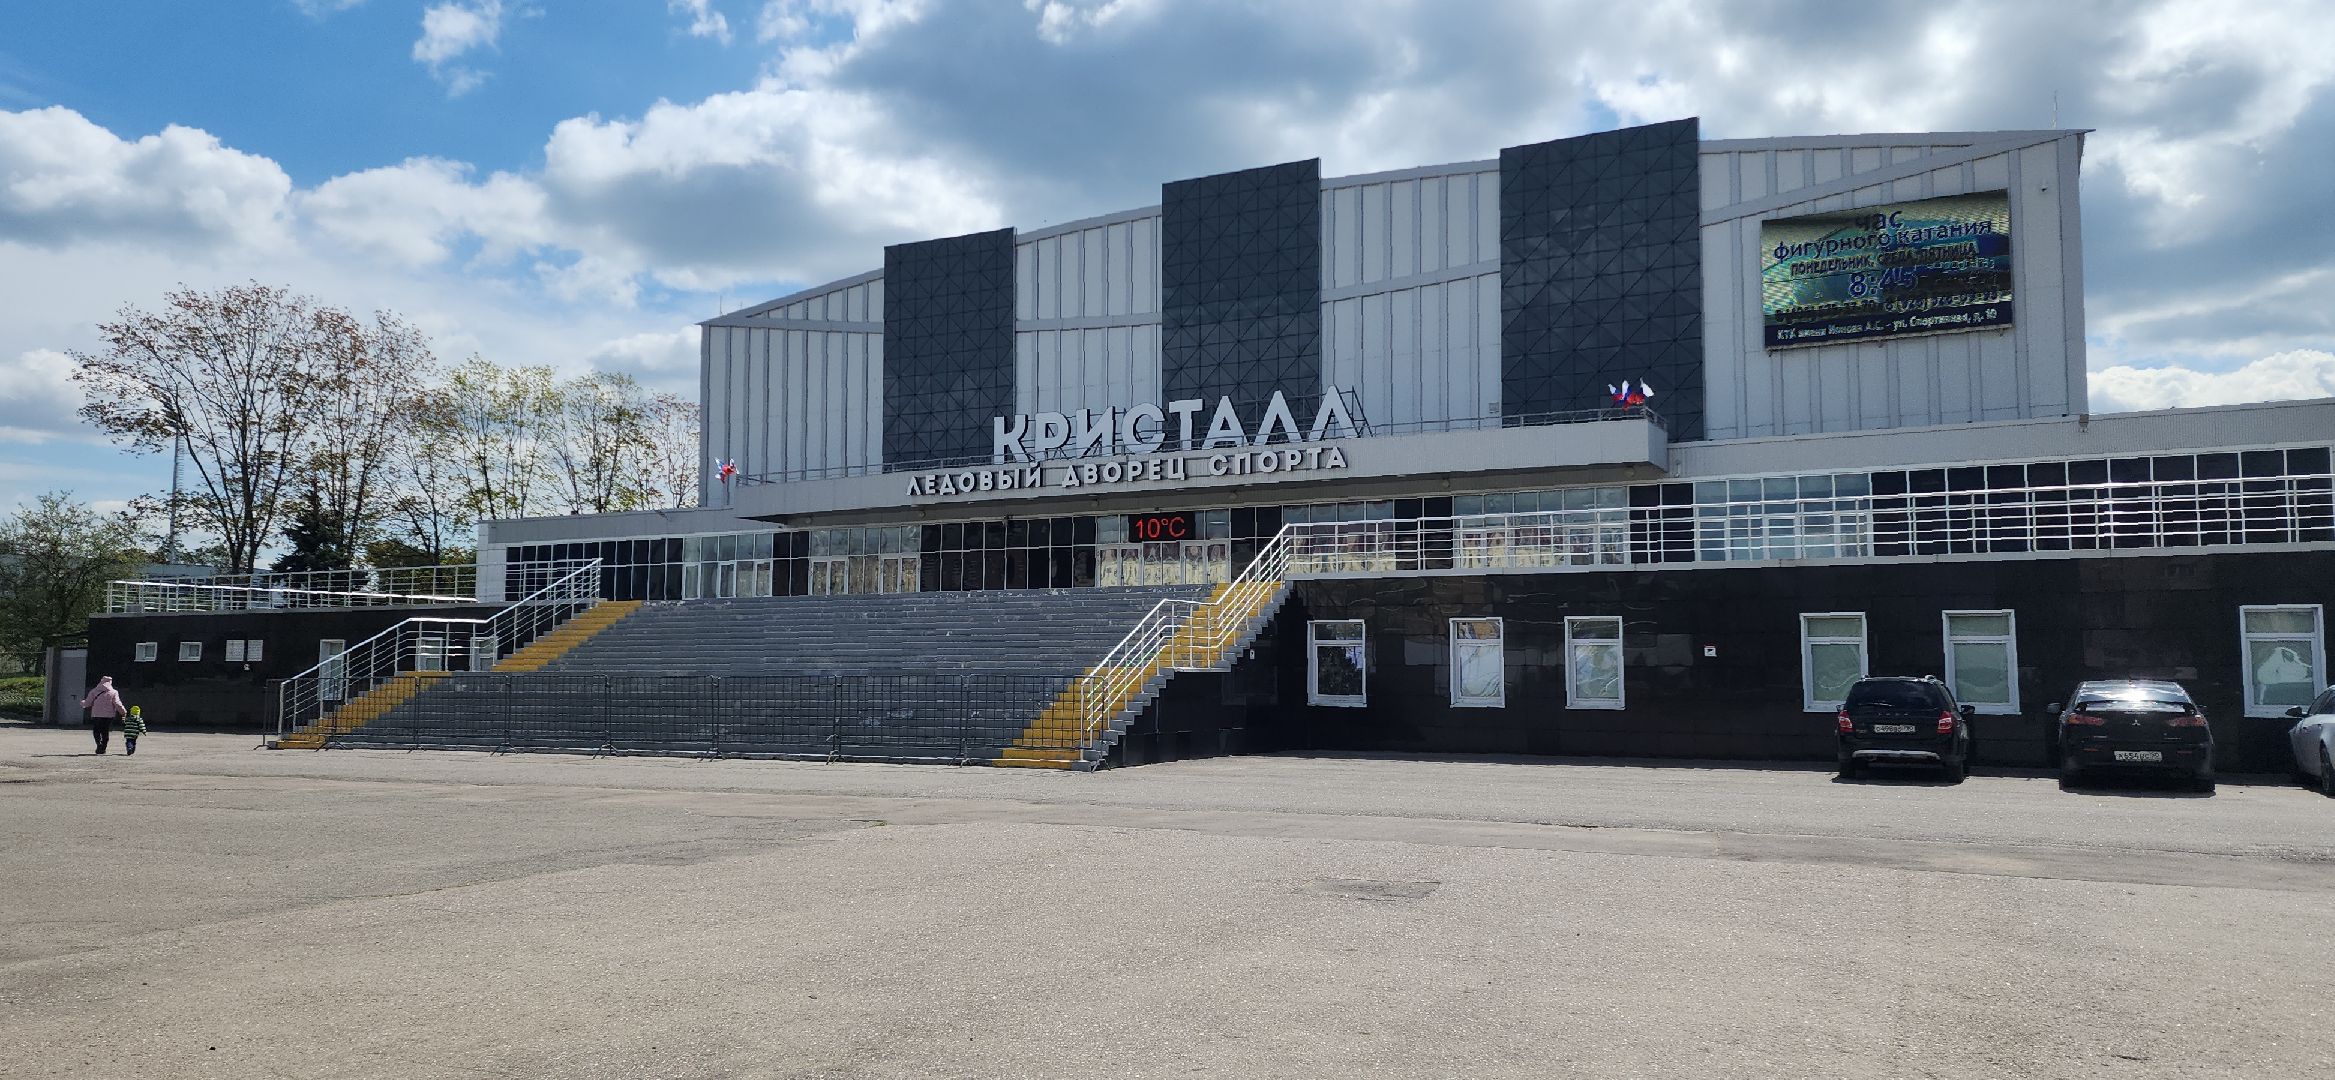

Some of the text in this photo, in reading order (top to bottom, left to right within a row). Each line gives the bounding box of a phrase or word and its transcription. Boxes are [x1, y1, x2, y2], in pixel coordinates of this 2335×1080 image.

[1774, 221, 1992, 264] фигурного катания
[993, 384, 1361, 465] КРИСТАЛЛ
[906, 446, 1348, 496] ЛЕДОВЫЙ ДВОРЕЦ СПОРТА
